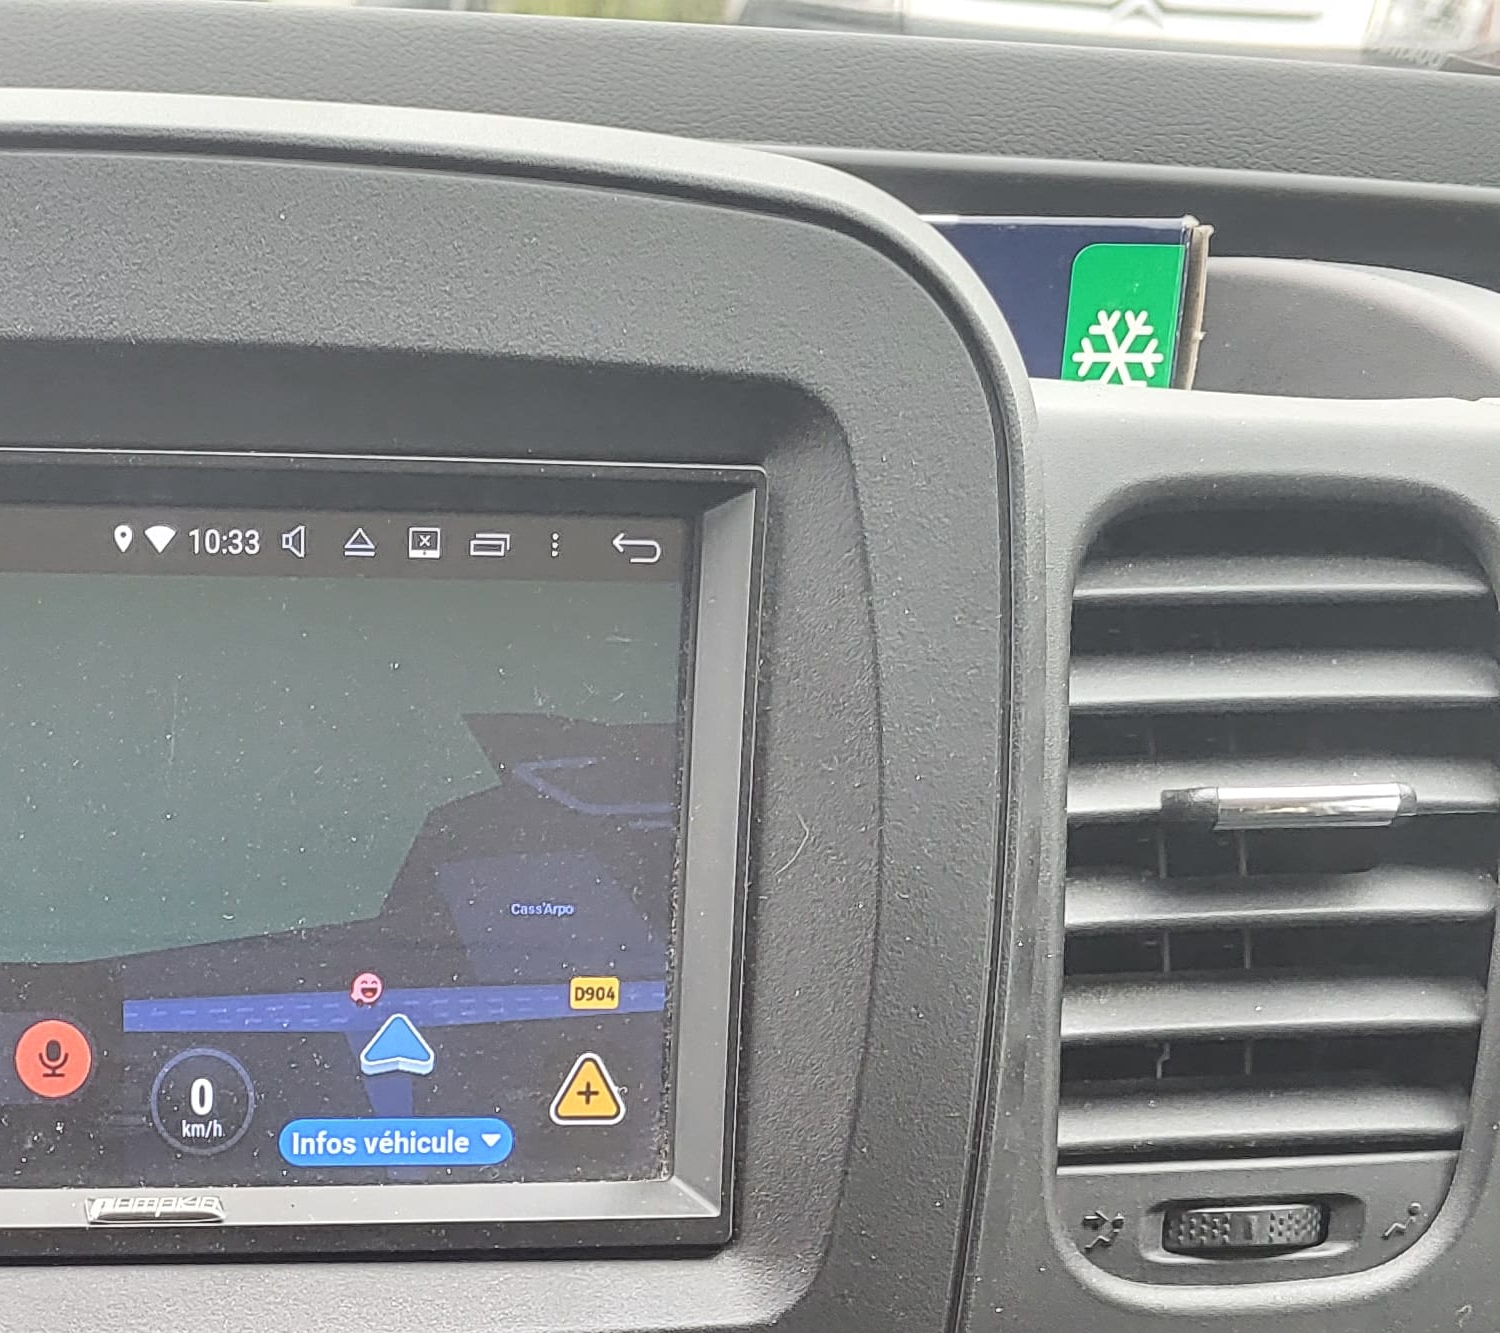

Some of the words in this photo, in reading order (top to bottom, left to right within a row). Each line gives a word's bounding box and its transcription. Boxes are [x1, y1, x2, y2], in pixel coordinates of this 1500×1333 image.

[188, 527, 261, 555] 10:33
[510, 903, 575, 917] Cass'Arpo
[574, 986, 616, 1002] D904
[190, 1078, 214, 1116] 0
[181, 1119, 223, 1138] km/h
[292, 1131, 358, 1156] Infos
[364, 1128, 470, 1155] véhicule
